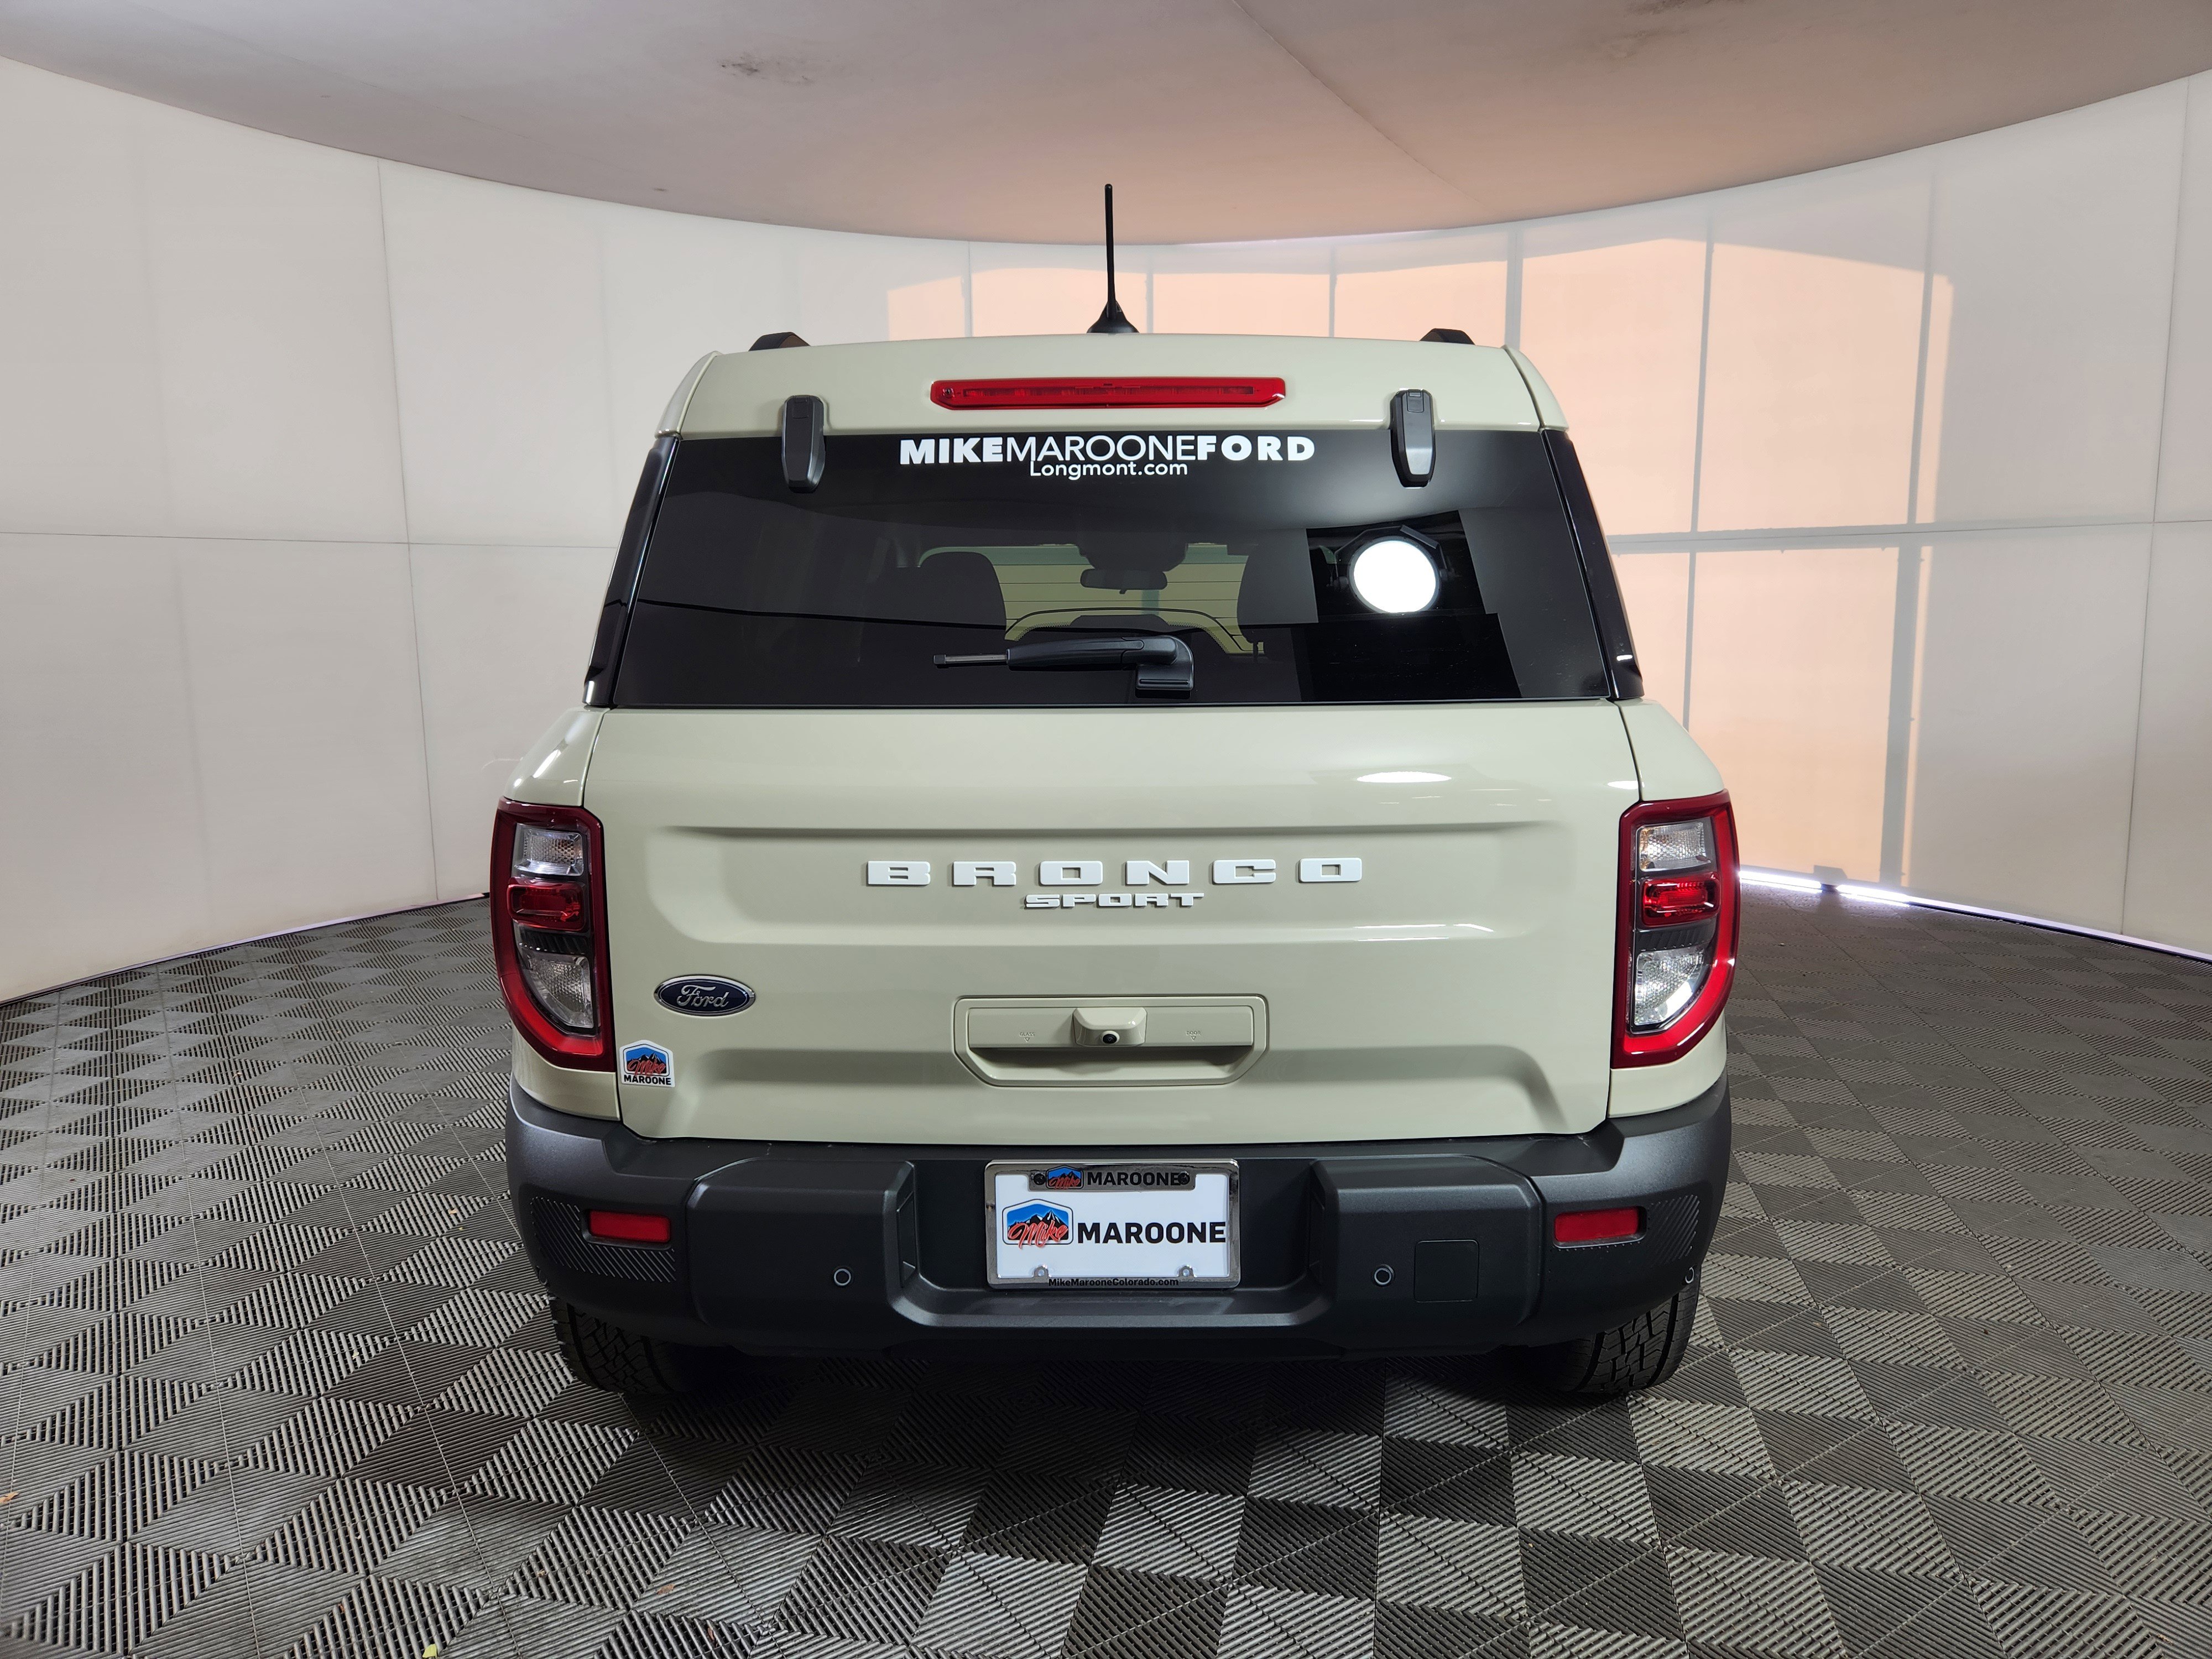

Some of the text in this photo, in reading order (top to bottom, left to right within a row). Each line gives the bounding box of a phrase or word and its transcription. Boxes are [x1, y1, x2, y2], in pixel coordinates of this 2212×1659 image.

[1030, 460, 1188, 480] Longmont.com
[867, 858, 1363, 886] BRONCO
[1024, 891, 1204, 909] SPORT
[676, 984, 729, 1008] Ford
[627, 1059, 666, 1077] Mike
[624, 1074, 671, 1085] MAROONE
[1087, 1171, 1182, 1186] MAROONE
[1008, 1219, 1226, 1250] Mike MAROONE
[1048, 1278, 1179, 1287] MikeMarooneColorado.com
